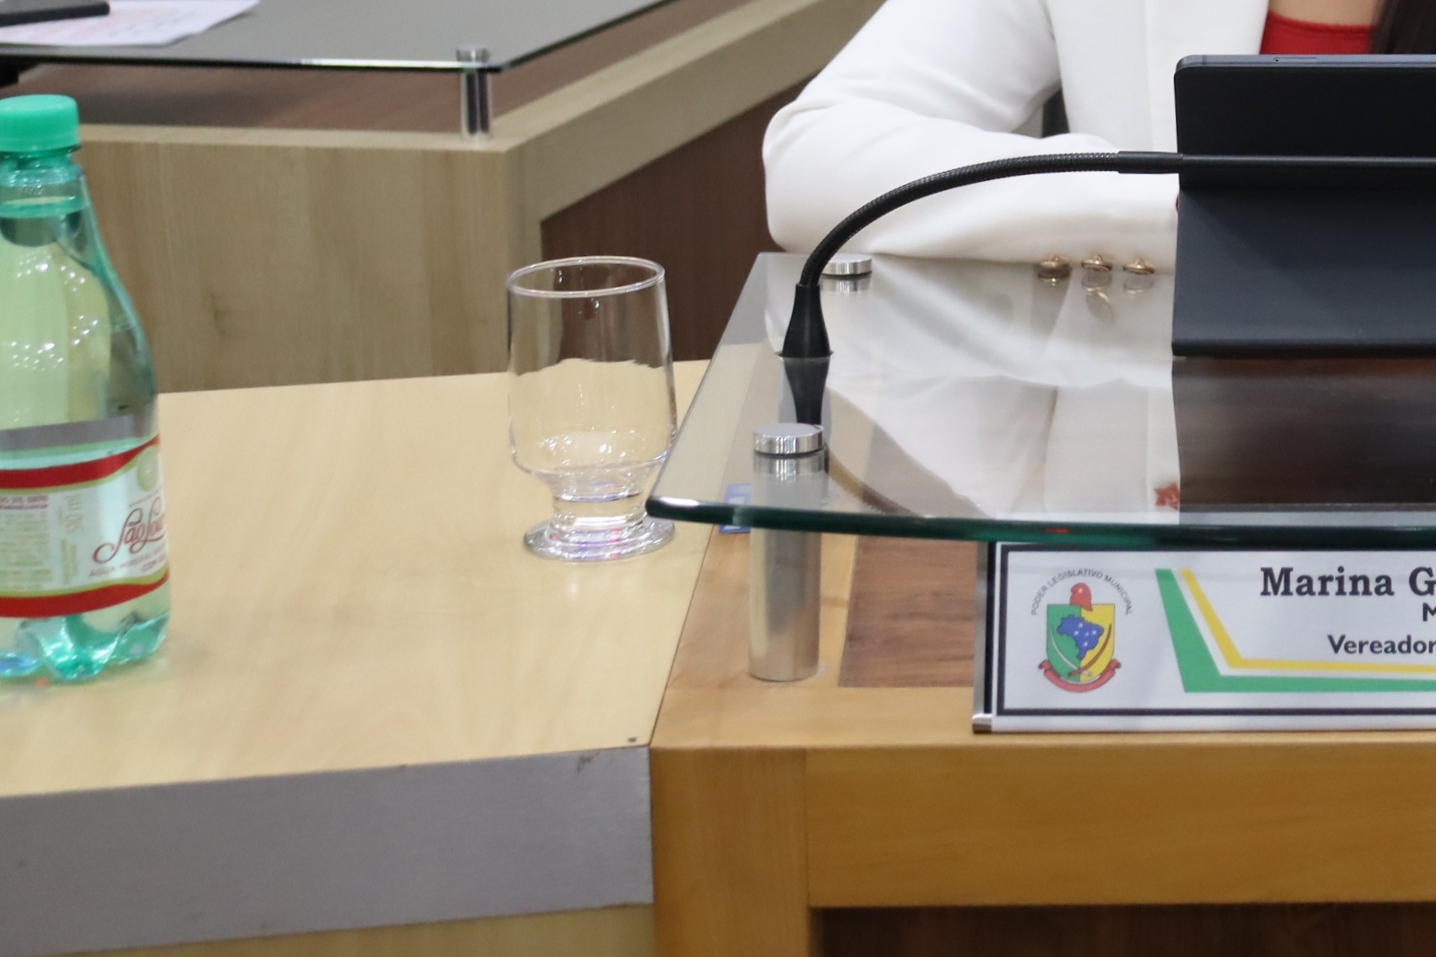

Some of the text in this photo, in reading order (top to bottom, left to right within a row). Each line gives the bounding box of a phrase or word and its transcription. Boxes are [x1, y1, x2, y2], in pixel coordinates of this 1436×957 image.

[1031, 569, 1133, 616] PODER LEGISLATIVO MUNICIPAL
[1260, 565, 1395, 596] Marina
